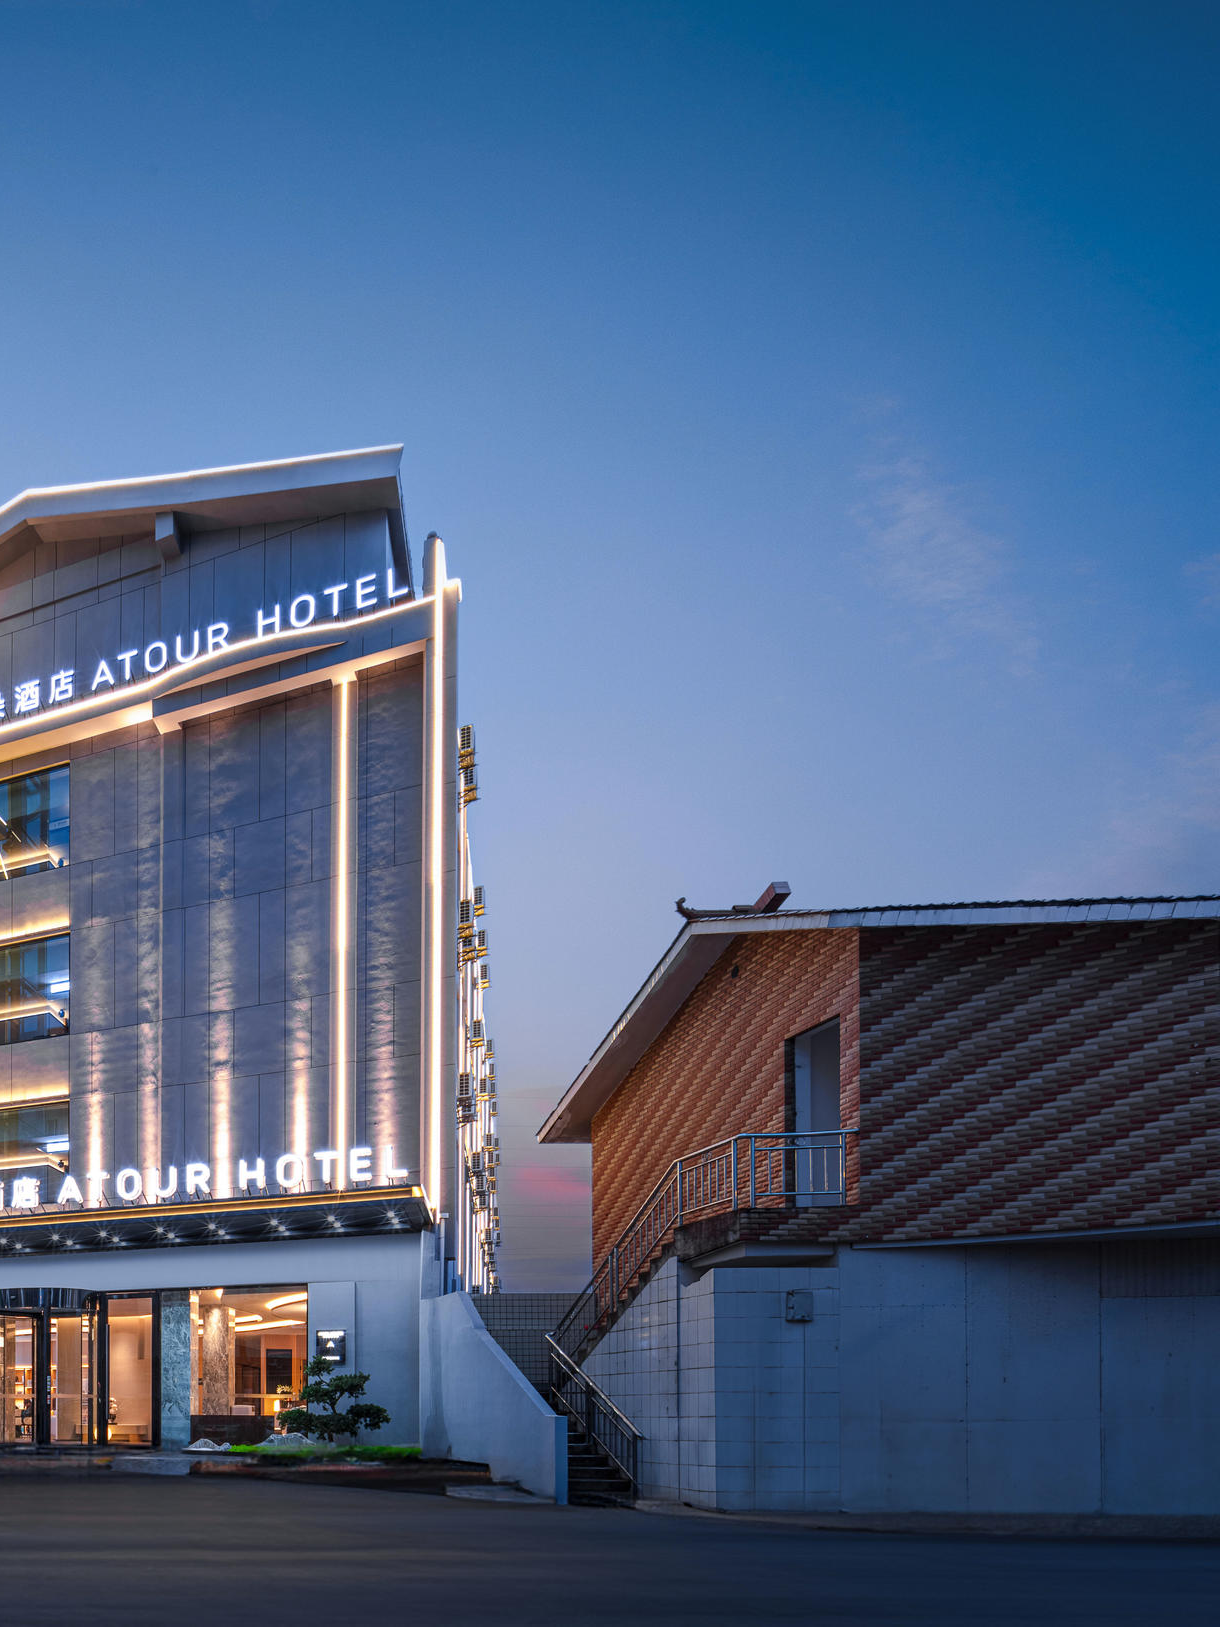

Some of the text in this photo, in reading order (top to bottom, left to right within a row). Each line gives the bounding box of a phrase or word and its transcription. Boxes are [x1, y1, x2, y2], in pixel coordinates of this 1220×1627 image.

[91, 621, 230, 691] ATOUR
[256, 568, 409, 639] HOTEL
[57, 1162, 211, 1205] ATOUR
[238, 1145, 408, 1196] HOTEL
